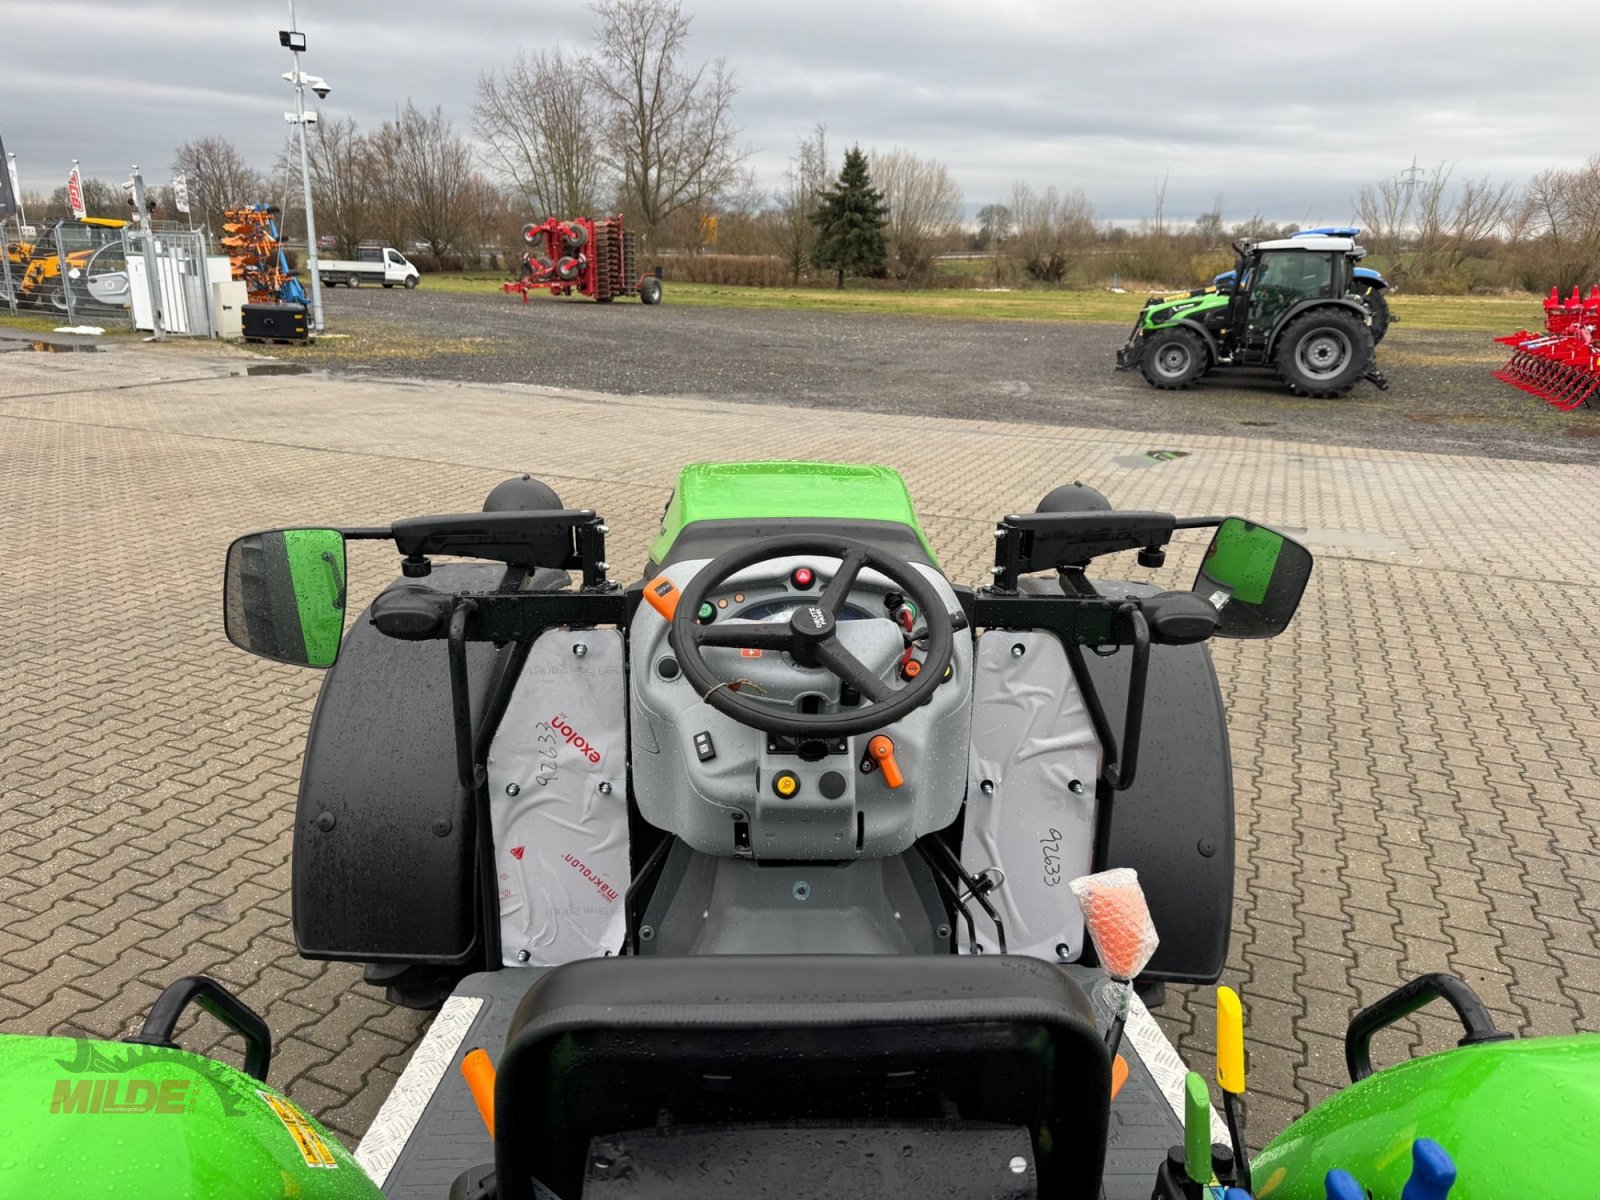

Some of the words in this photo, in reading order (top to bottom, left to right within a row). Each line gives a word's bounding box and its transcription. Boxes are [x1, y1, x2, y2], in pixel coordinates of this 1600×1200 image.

[535, 721, 559, 787] 92633
[551, 715, 601, 763] exolon
[1040, 828, 1062, 887] 92633
